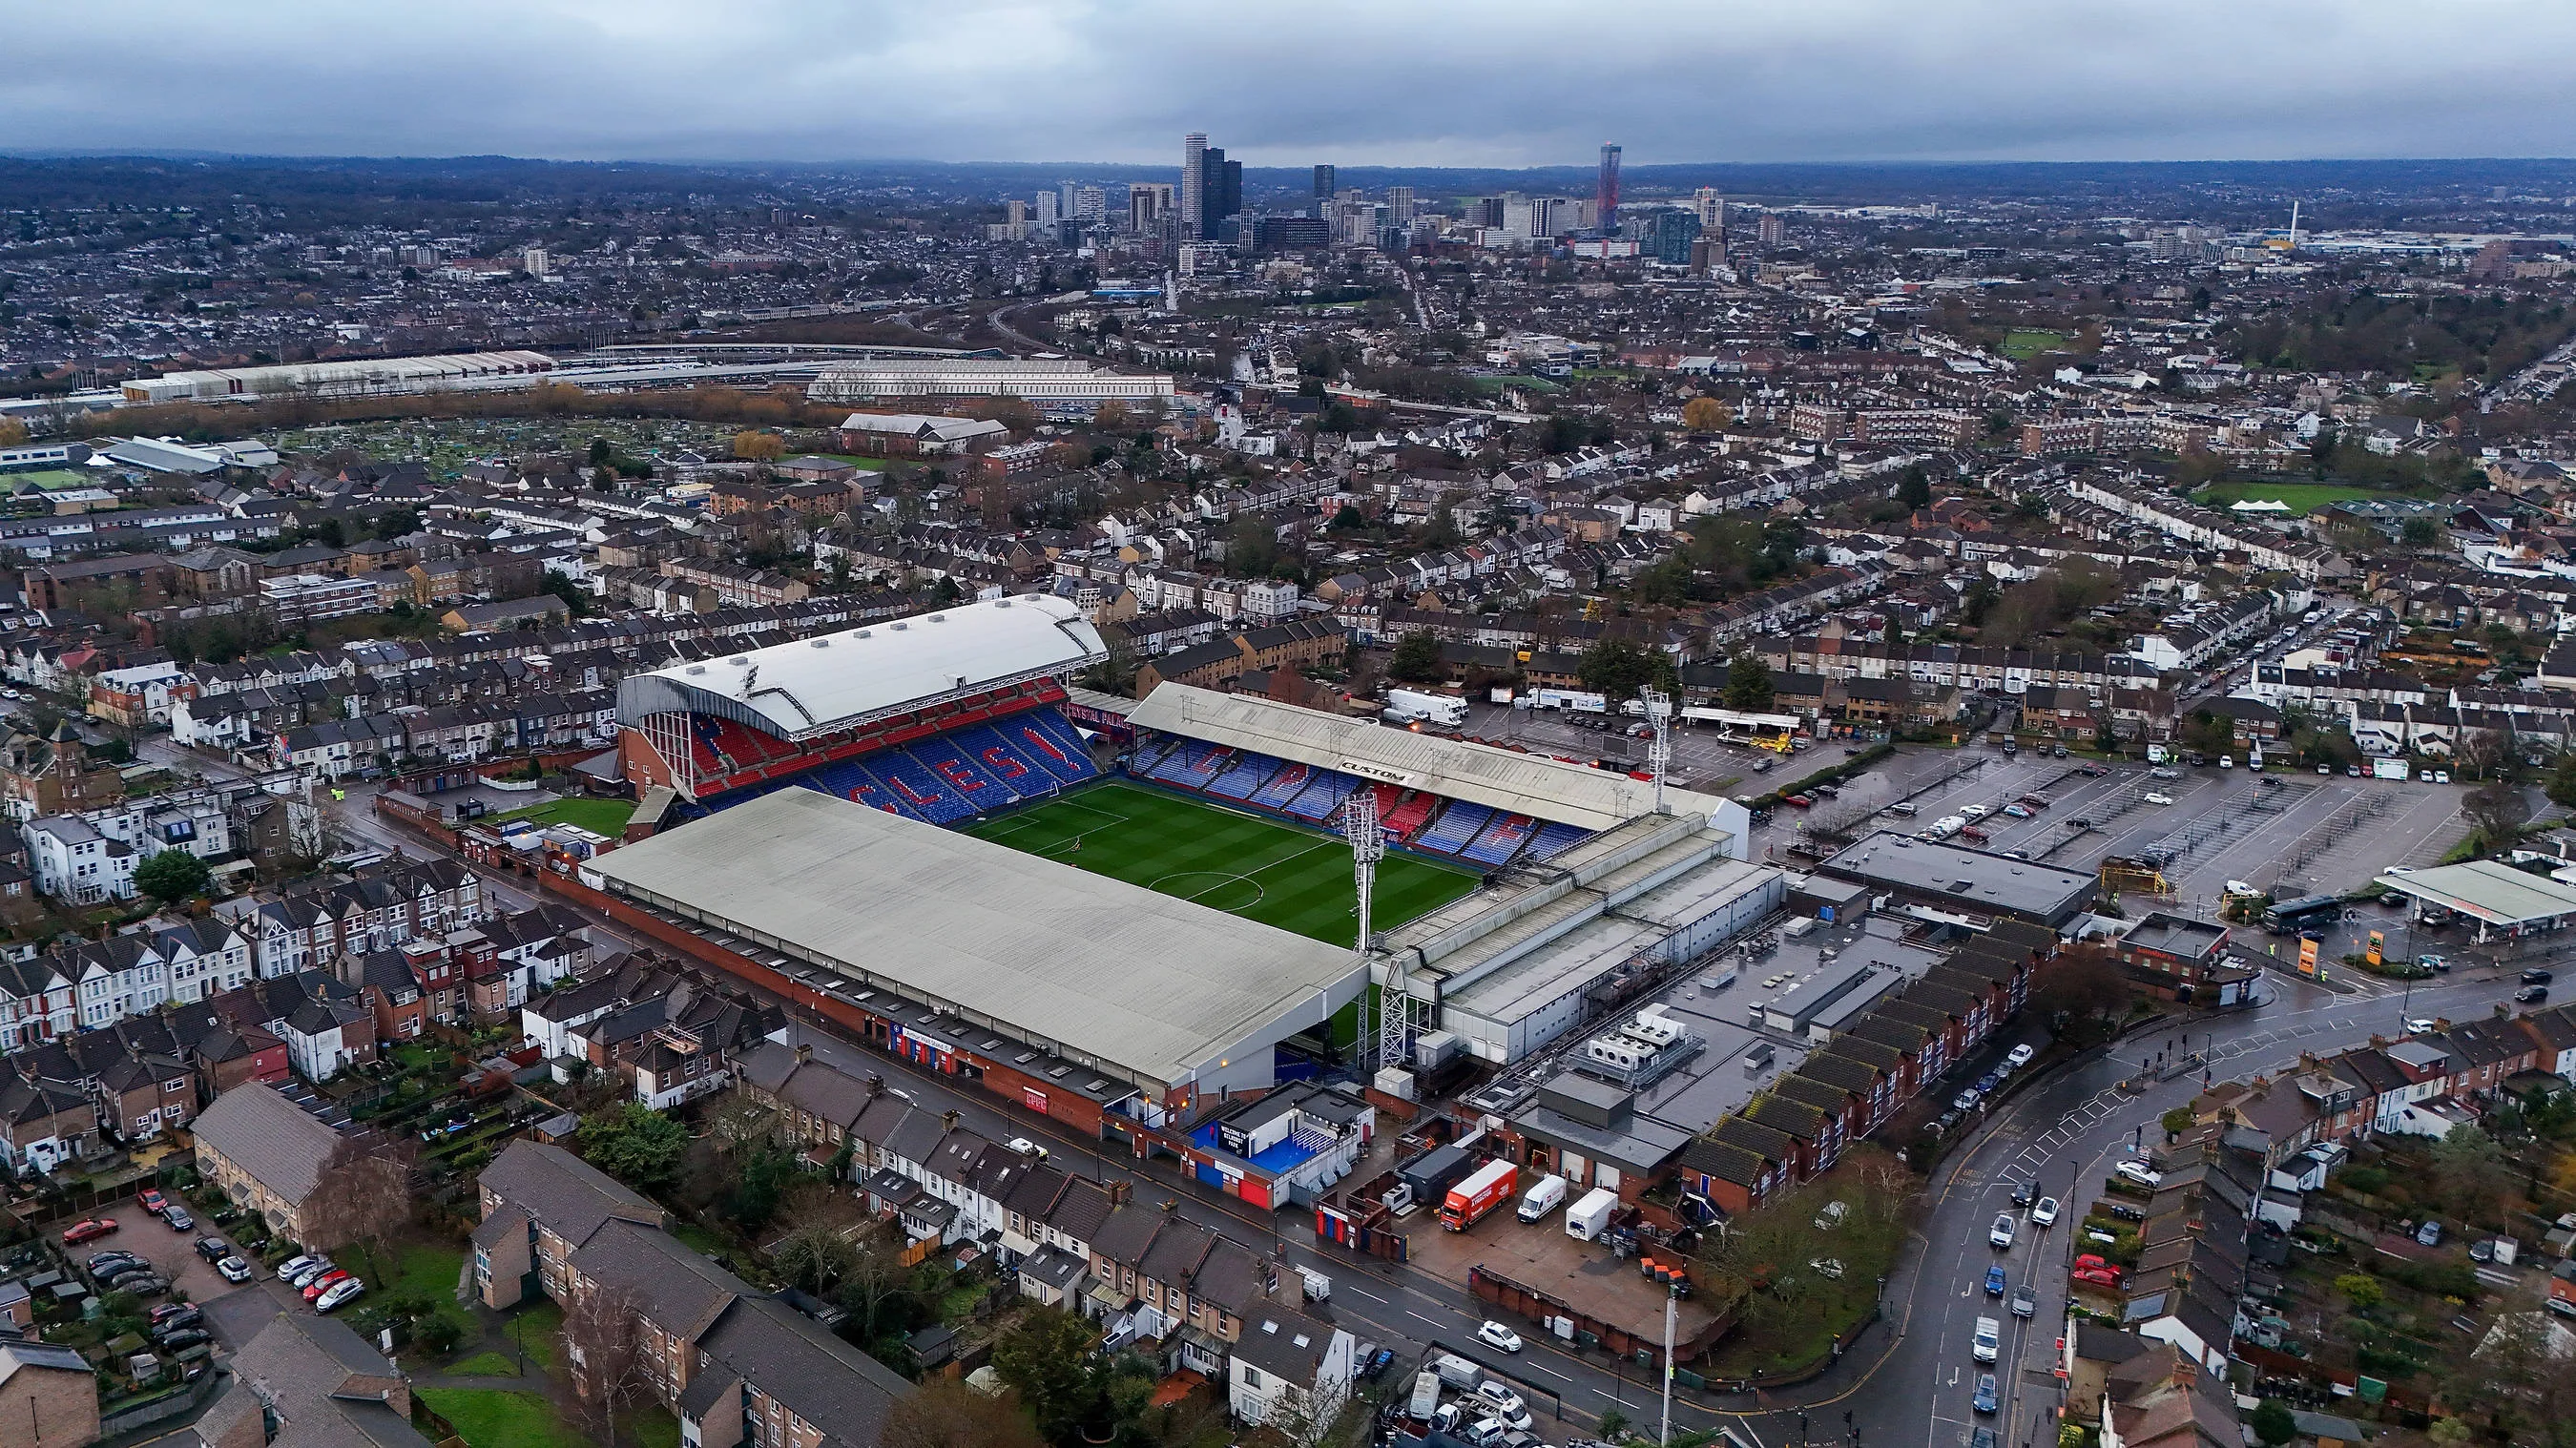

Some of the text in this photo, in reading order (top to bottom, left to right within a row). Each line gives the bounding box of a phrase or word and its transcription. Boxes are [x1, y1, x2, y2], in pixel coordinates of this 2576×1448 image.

[1341, 761, 1406, 781] CUSTOM
[1221, 1125, 1240, 1137] WELCOME
[1228, 1140, 1238, 1148] PARK
